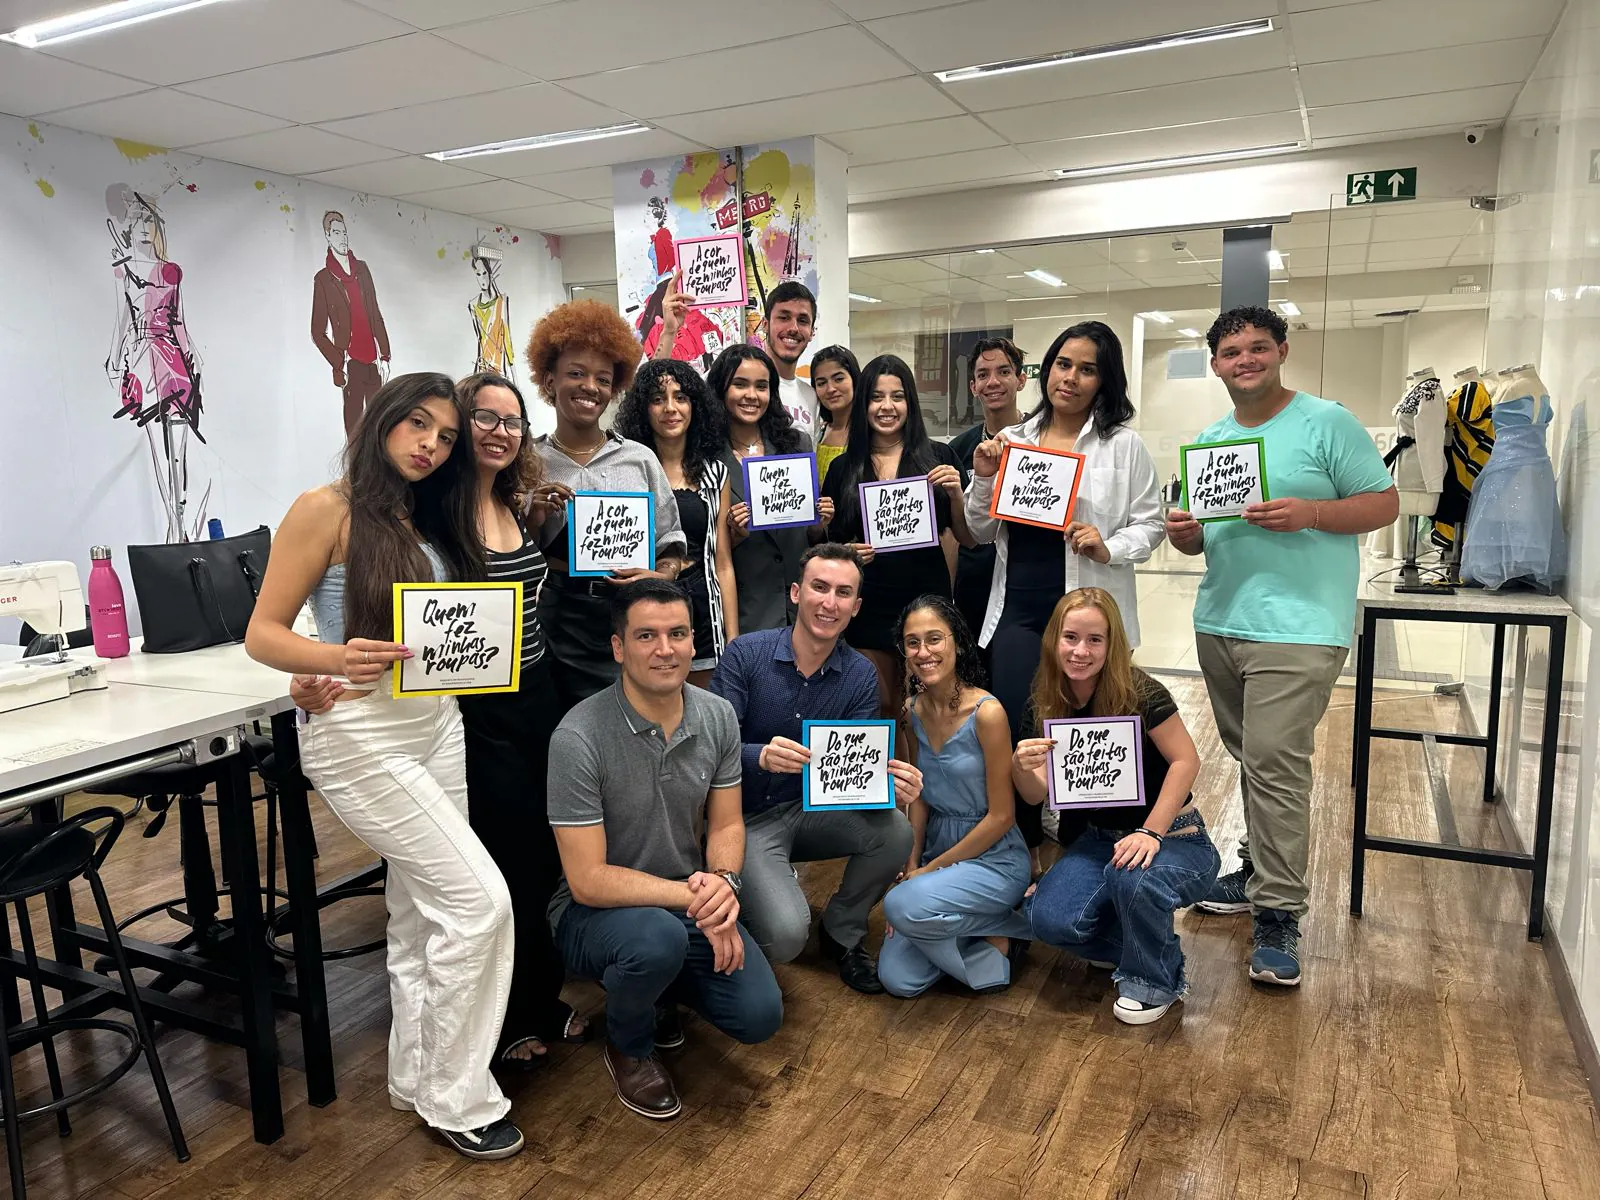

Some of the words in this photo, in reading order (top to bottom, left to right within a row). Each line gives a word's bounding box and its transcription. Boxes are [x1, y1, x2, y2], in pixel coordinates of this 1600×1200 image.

[697, 245, 703, 262] A
[705, 246, 722, 258] cor
[689, 259, 701, 275] de
[702, 255, 730, 273] quem
[686, 276, 702, 292] fez
[702, 266, 736, 284] minhas
[695, 277, 732, 296] roupas?
[1017, 455, 1053, 474] Quem
[1207, 451, 1214, 471] A
[1217, 452, 1238, 467] cor
[760, 466, 789, 483] Quem
[1028, 471, 1050, 486] fez
[1197, 468, 1212, 485] de
[1214, 462, 1248, 483] quem
[772, 478, 791, 493] fez
[1012, 484, 1053, 497] minhas
[1192, 486, 1214, 505] fez
[1214, 476, 1256, 494] minhas
[762, 488, 797, 505] minhas
[765, 494, 806, 515] roupas?
[879, 488, 891, 507] Do
[892, 487, 910, 501] que
[1012, 494, 1061, 511] roupas?
[1204, 488, 1250, 509] roupas?
[597, 499, 604, 520] A
[607, 504, 629, 518] cor
[874, 506, 891, 522] são
[893, 497, 923, 516] feitas
[586, 516, 602, 535] de
[604, 516, 638, 533] quem
[877, 513, 911, 531] minhas
[880, 518, 920, 540] roupas?
[580, 535, 603, 555] fez
[603, 529, 645, 546] minhas
[592, 541, 639, 561] roupas?
[423, 598, 476, 627] Quem
[444, 618, 477, 644] fez
[422, 636, 486, 661] minhas
[425, 646, 500, 675] roupas?
[826, 730, 842, 753] Do
[844, 732, 867, 747] que
[1069, 728, 1085, 751] Do
[1087, 729, 1110, 745] que
[817, 752, 841, 770] são
[843, 745, 881, 766] feitas
[1061, 750, 1085, 768] são
[1087, 742, 1127, 764] feitas
[820, 763, 864, 782] minhas
[1065, 761, 1110, 780] minhas
[1068, 769, 1121, 792] roupas?
[823, 771, 874, 794] roupas?
